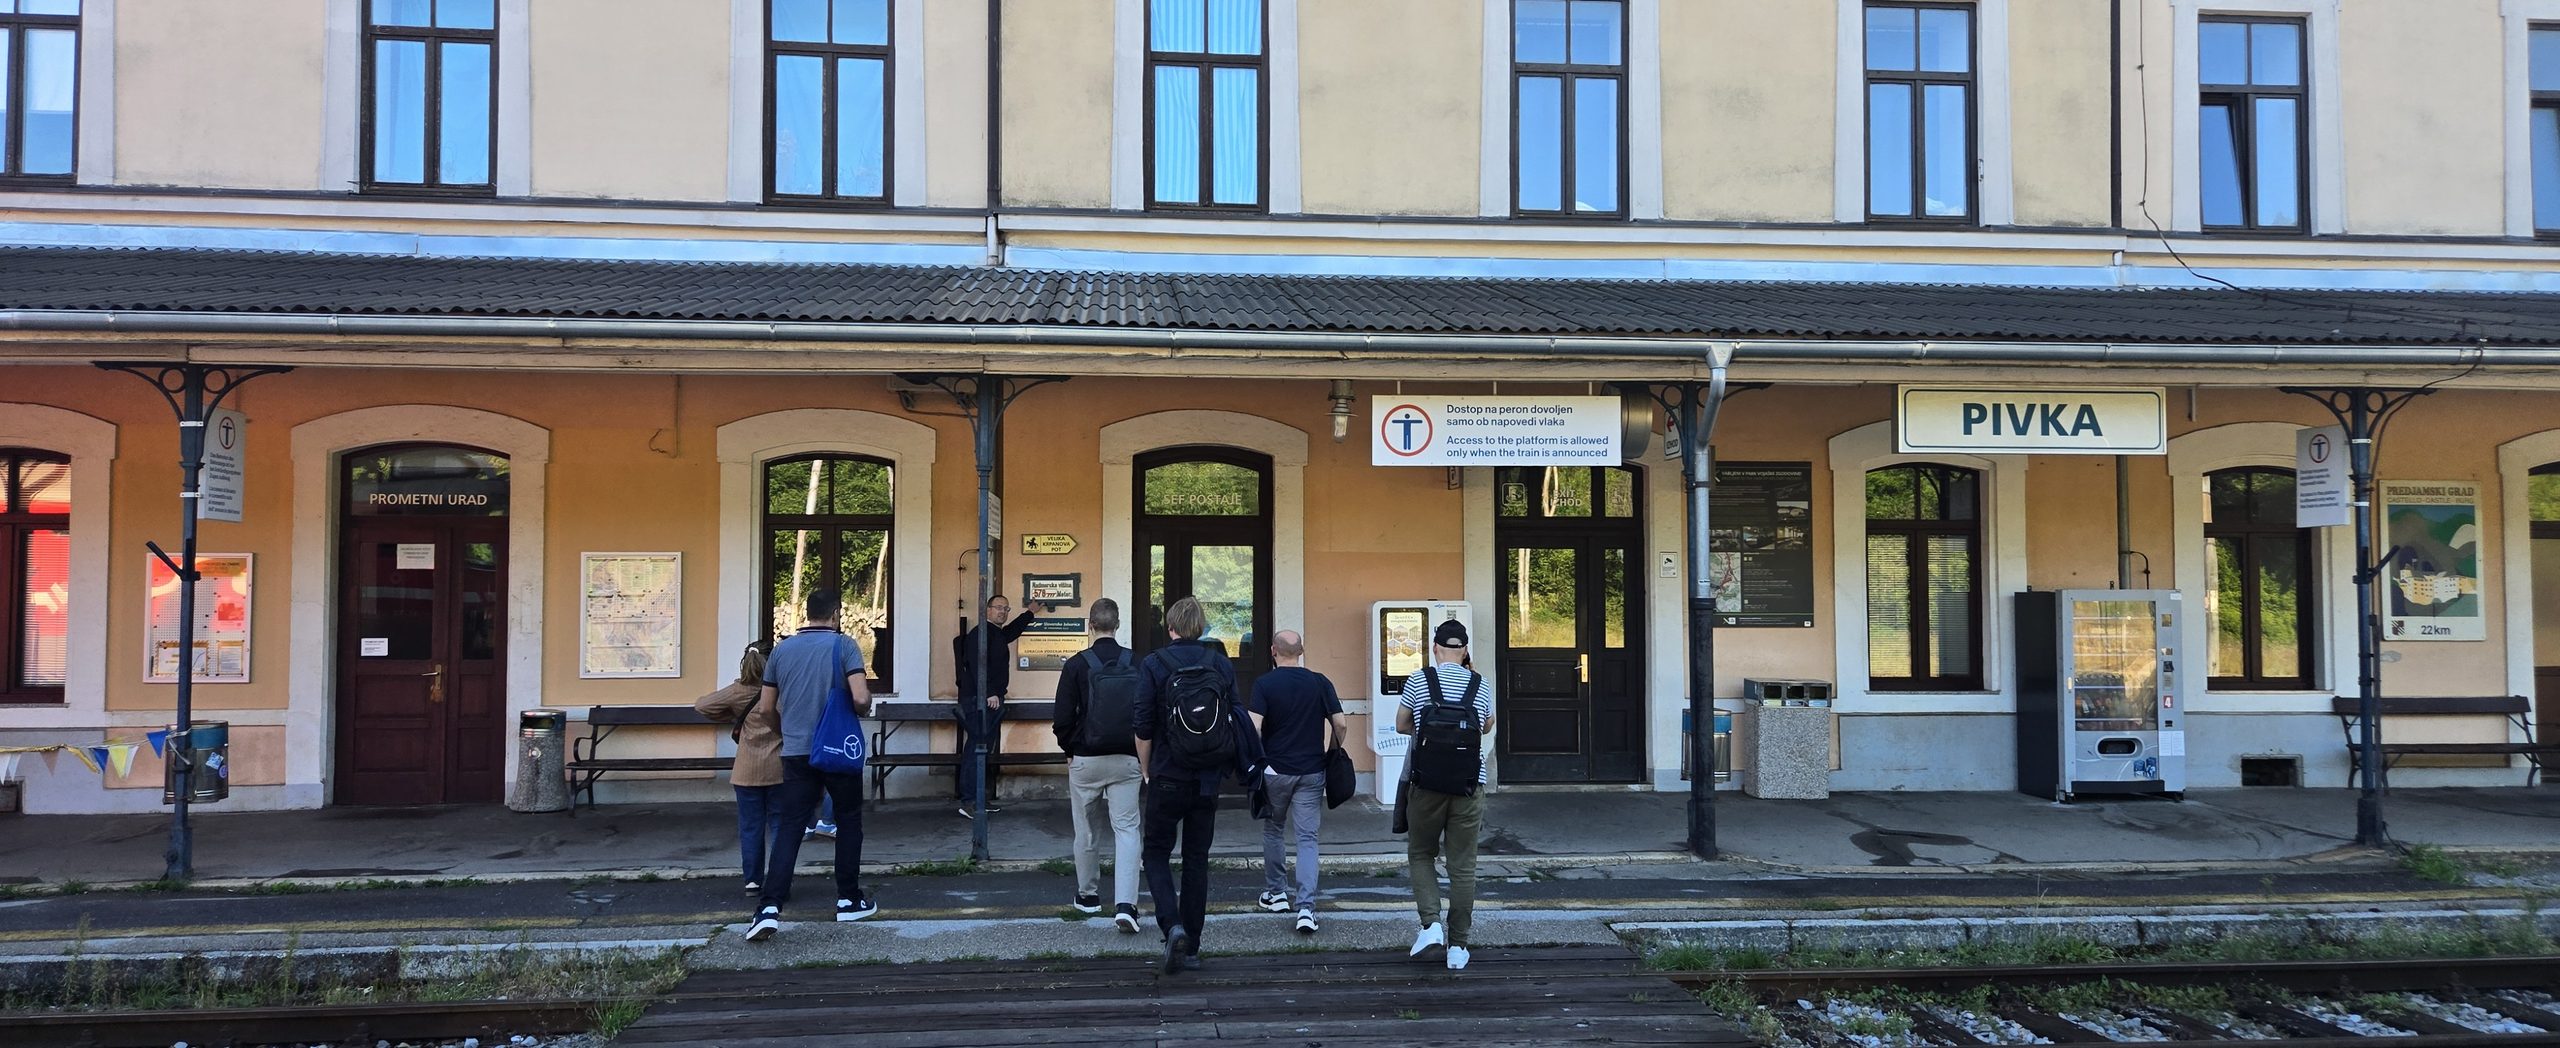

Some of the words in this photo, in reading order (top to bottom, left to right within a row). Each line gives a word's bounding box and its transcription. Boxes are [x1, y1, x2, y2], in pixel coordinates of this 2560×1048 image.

[1446, 404, 1482, 416] Dostop
[1500, 407, 1528, 416] peron
[1530, 404, 1573, 416] dovoljen
[1476, 417, 1489, 426] ob
[1491, 417, 1537, 428] napovedi
[1538, 417, 1565, 426] vlaka
[1962, 402, 2103, 436] PIVKA
[1446, 436, 1484, 445] Access
[1485, 436, 1494, 445] to
[1497, 436, 1514, 445] the
[1516, 436, 1558, 447] platform
[1560, 436, 1568, 445] is
[1570, 436, 1609, 445] allowed
[1446, 448, 1468, 459] only
[1470, 448, 1497, 457] when
[1499, 448, 1515, 457] the
[1517, 448, 1540, 457] train
[1542, 448, 1550, 457] is
[1552, 448, 1608, 457] announced
[2386, 486, 2446, 496] PREDJAMSKI
[2448, 487, 2474, 496] GRAD
[369, 493, 443, 505] PROMETNI
[448, 494, 488, 506] URAD
[1189, 494, 1242, 505] POSTAJE
[1550, 498, 1582, 507] IZHOD
